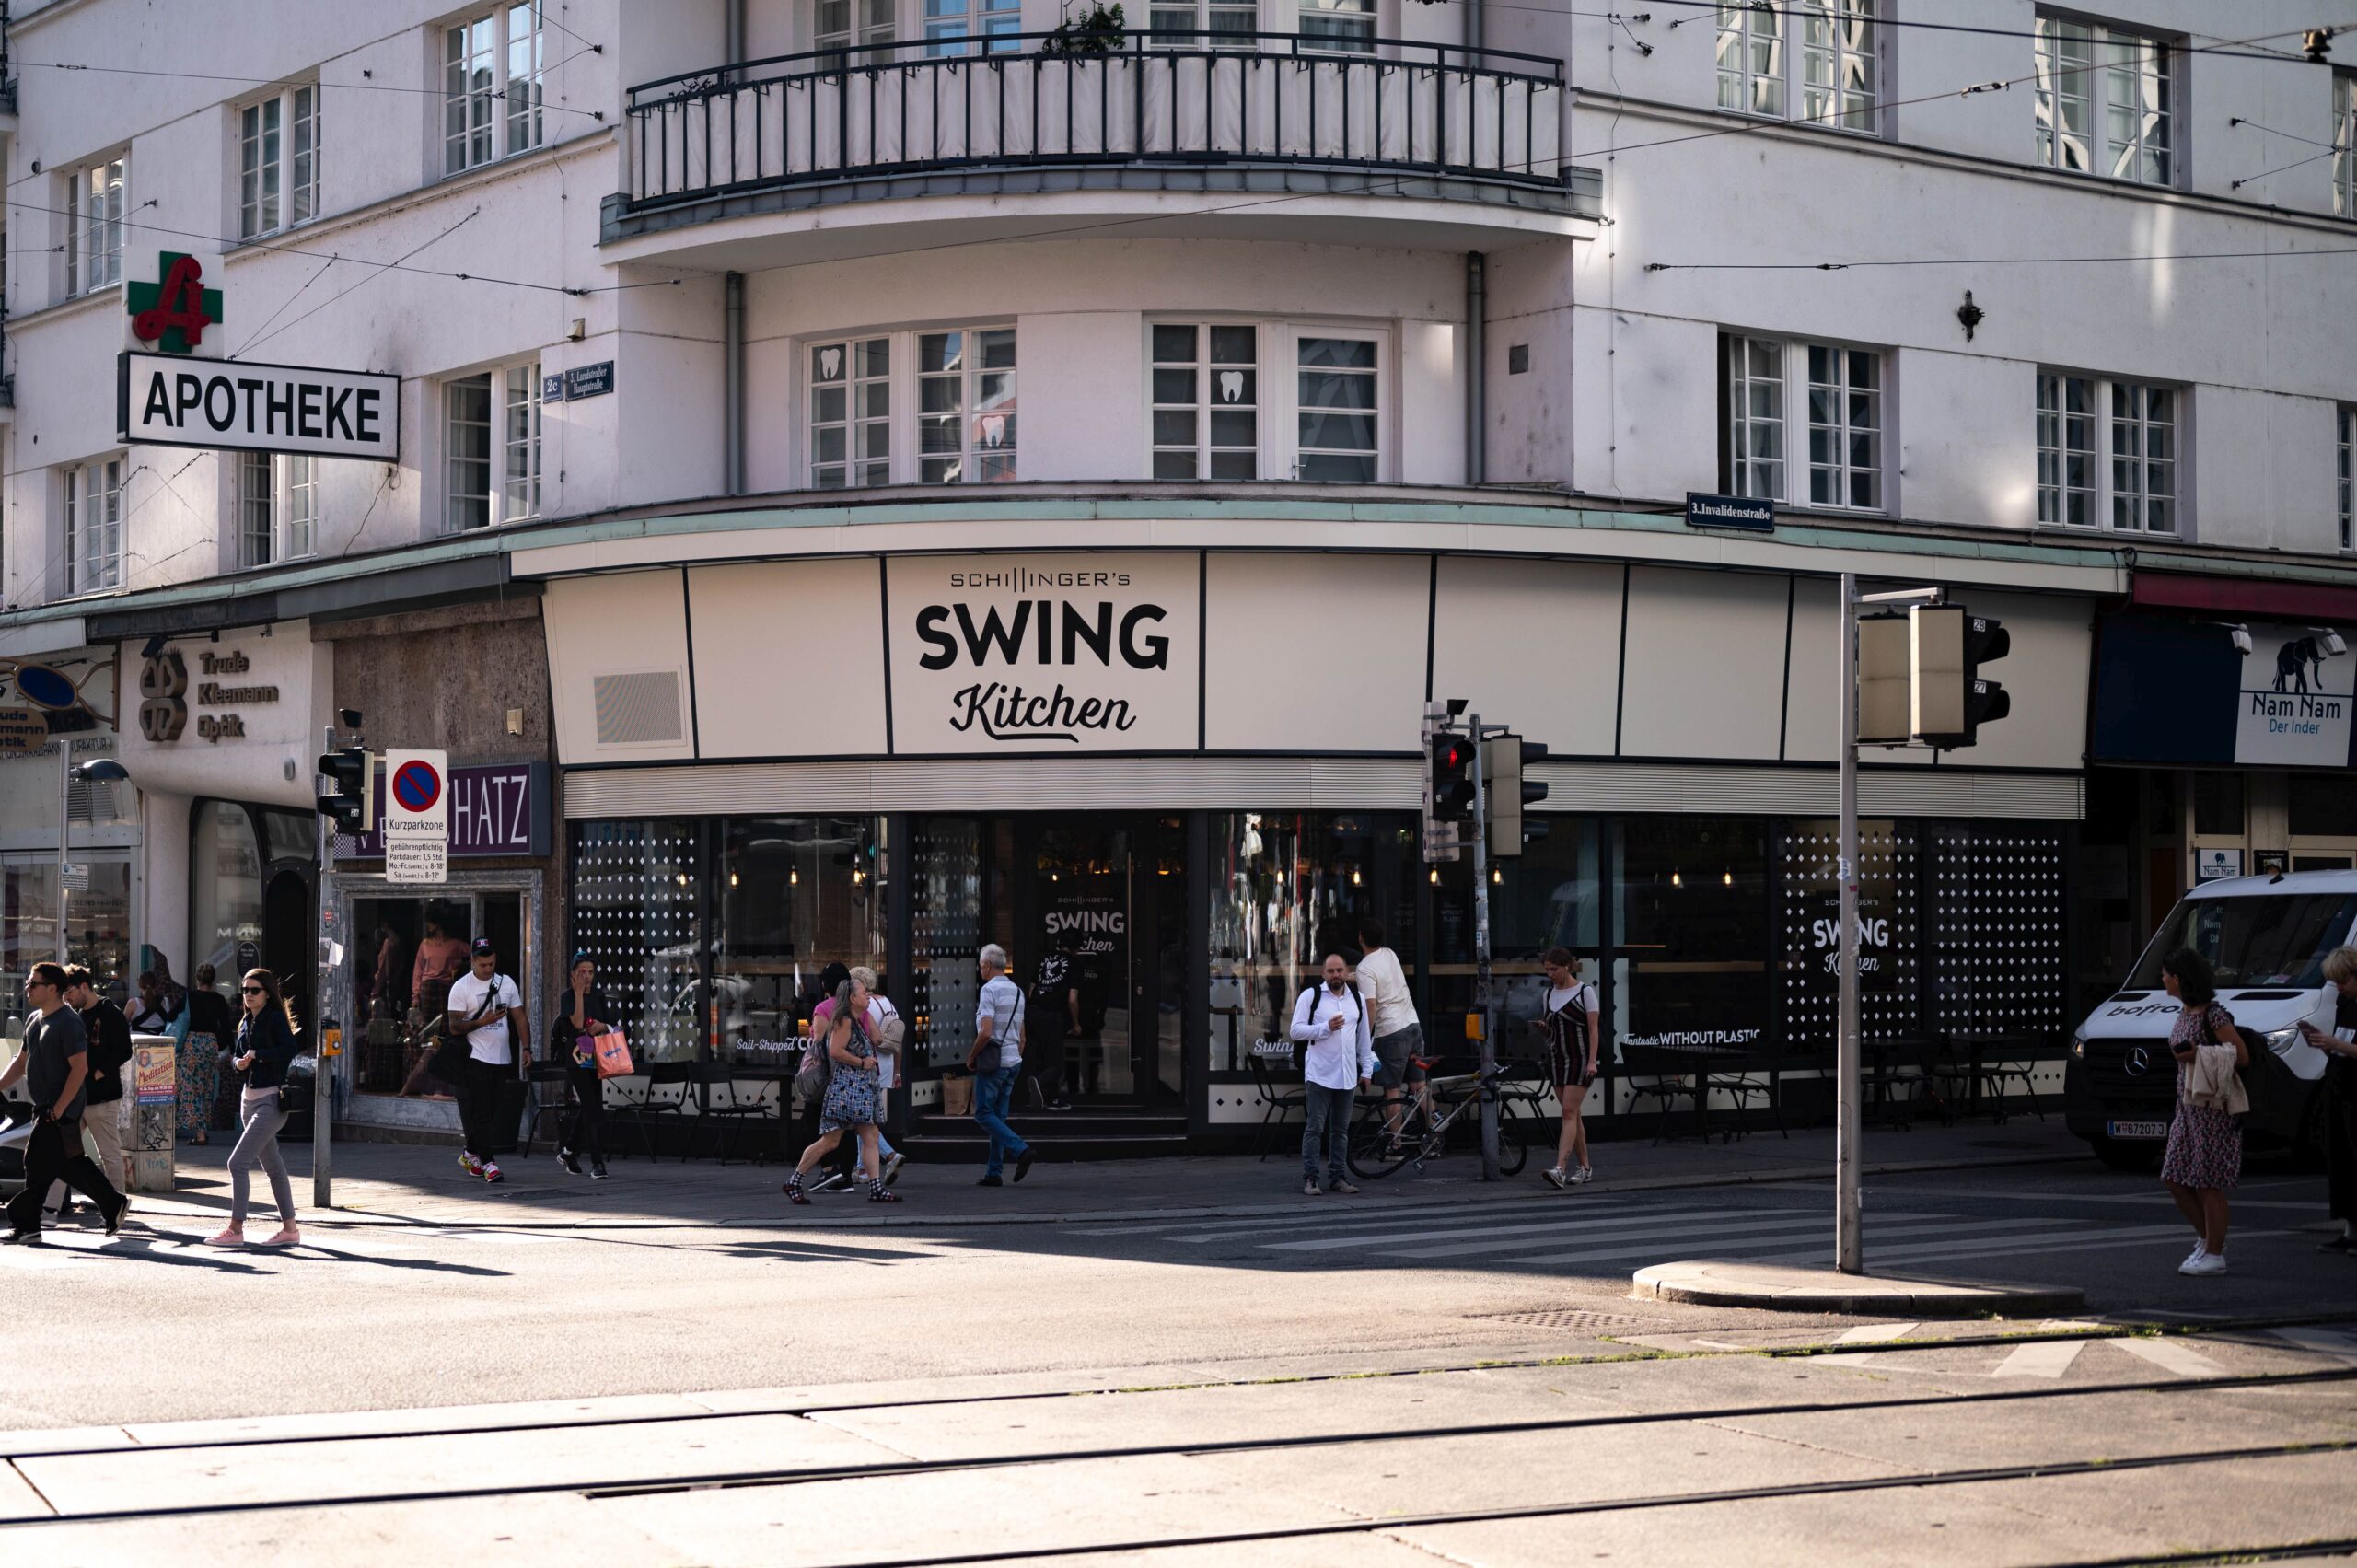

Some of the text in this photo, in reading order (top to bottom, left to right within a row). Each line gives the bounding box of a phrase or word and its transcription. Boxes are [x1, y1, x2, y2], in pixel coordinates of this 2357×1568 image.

[576, 366, 608, 382] Landstraßer
[547, 378, 558, 393] 2c
[573, 378, 604, 396] Hauptstraße
[142, 371, 381, 443] APOTHEKE
[1974, 620, 1985, 631] 28
[916, 600, 1169, 670] SWING
[198, 650, 250, 674] Trude
[197, 682, 279, 705] Kleemann
[1975, 682, 1986, 692] 27
[949, 682, 1137, 743] Kitchen
[2252, 692, 2341, 719] Nam Nam
[0, 710, 28, 721] ude
[0, 725, 44, 734] mann
[197, 714, 246, 743] Optik
[2269, 718, 2320, 734] Der Inder
[0, 737, 27, 747] tik
[447, 775, 528, 846] HATZ
[389, 819, 444, 832] Kurzparkzone
[390, 843, 443, 852] gebührenpflichtig
[423, 853, 431, 861] 1,5
[2204, 866, 2235, 876] Nam Nam
[1045, 911, 1125, 934] SWING
[1813, 918, 1889, 948] SWNG
[2106, 1003, 2182, 1016] bofro
[737, 1036, 798, 1053] Sail-Shipped
[1623, 1033, 1660, 1046] Fantastic
[1659, 1031, 1714, 1045] WITHOUT
[139, 1060, 174, 1087] Meditation
[2114, 1123, 2121, 1134] W
[2128, 1123, 2156, 1134] 67207
